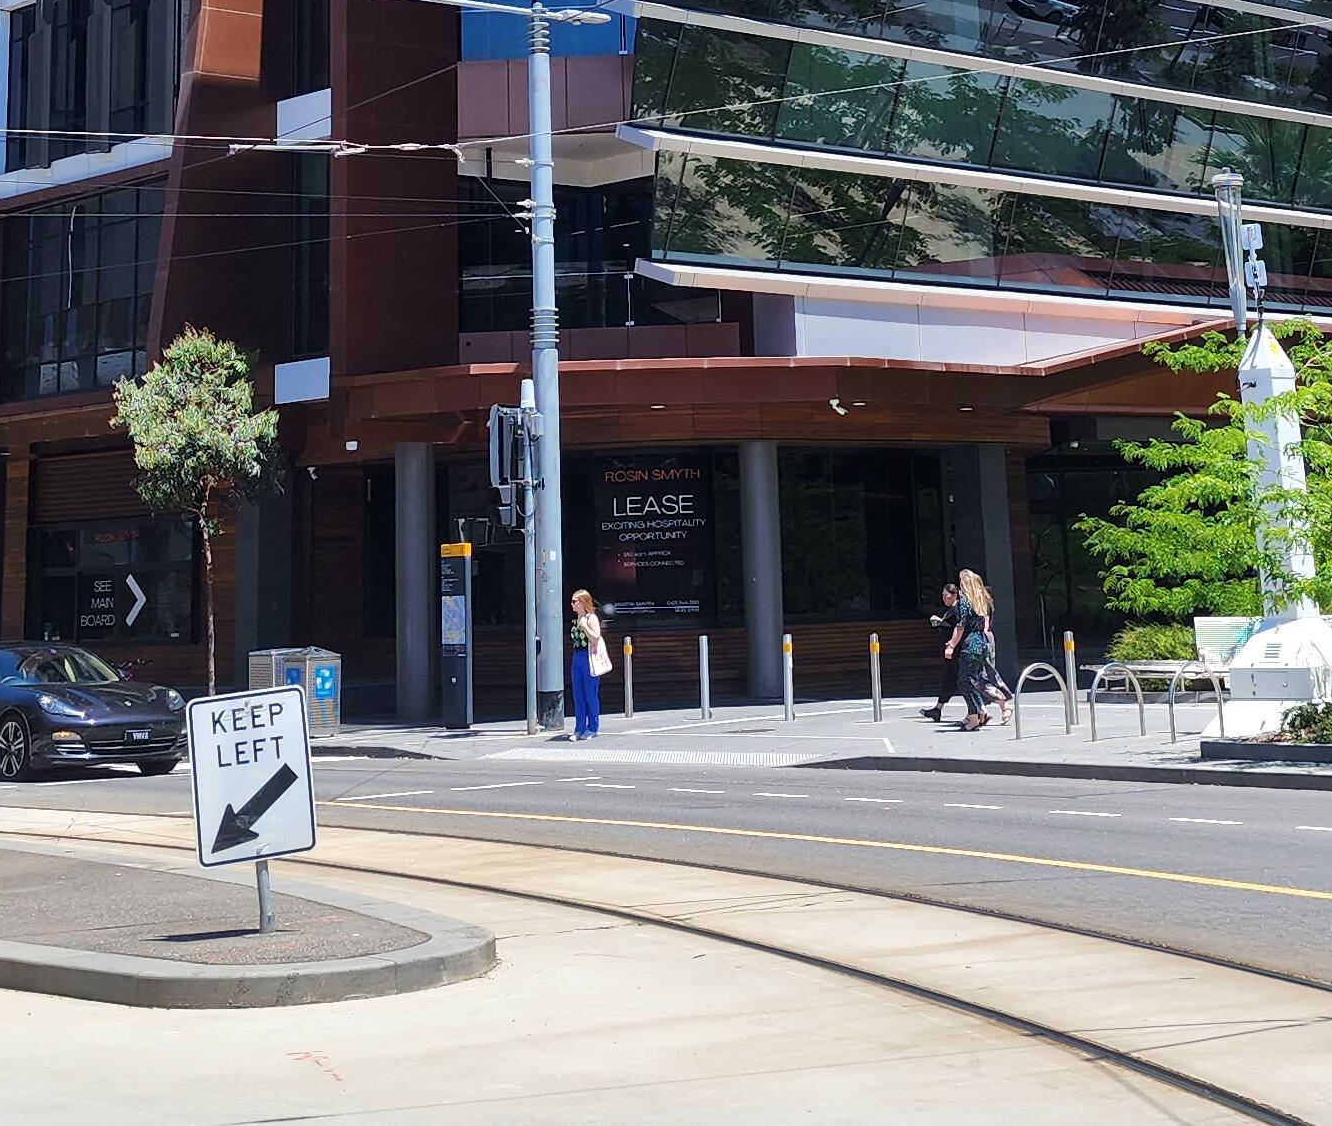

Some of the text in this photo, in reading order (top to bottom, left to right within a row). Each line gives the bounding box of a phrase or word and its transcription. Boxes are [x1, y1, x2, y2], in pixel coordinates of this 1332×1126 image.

[604, 468, 700, 483] ROSIN SMYTH
[613, 494, 695, 517] LEASE
[601, 518, 706, 531] EXCITING HOSPITALITY
[618, 530, 688, 542] OPPORTUNITY
[93, 579, 113, 593] SEE
[80, 614, 116, 627] BOARD
[211, 702, 284, 735] KEEP
[217, 735, 284, 768] LEFT
